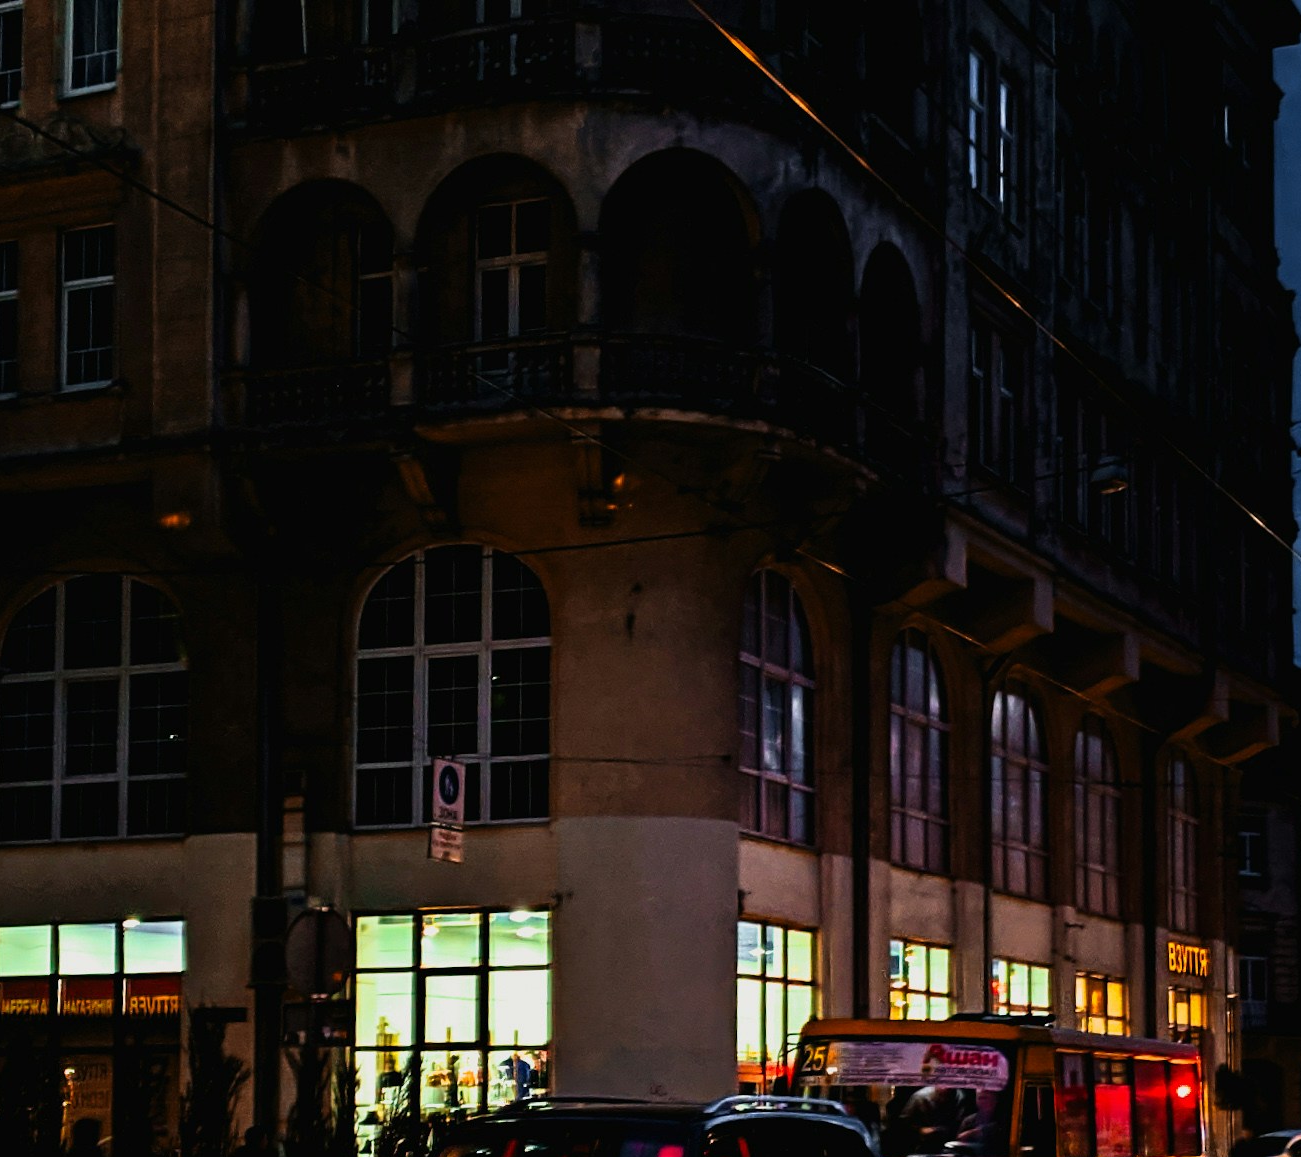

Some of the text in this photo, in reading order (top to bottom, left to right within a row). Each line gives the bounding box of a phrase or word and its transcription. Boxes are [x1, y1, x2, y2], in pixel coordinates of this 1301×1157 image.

[1168, 942, 1209, 977] ВЗУТТЯ
[801, 1044, 826, 1071] 25
[923, 1044, 998, 1066] Ашан
